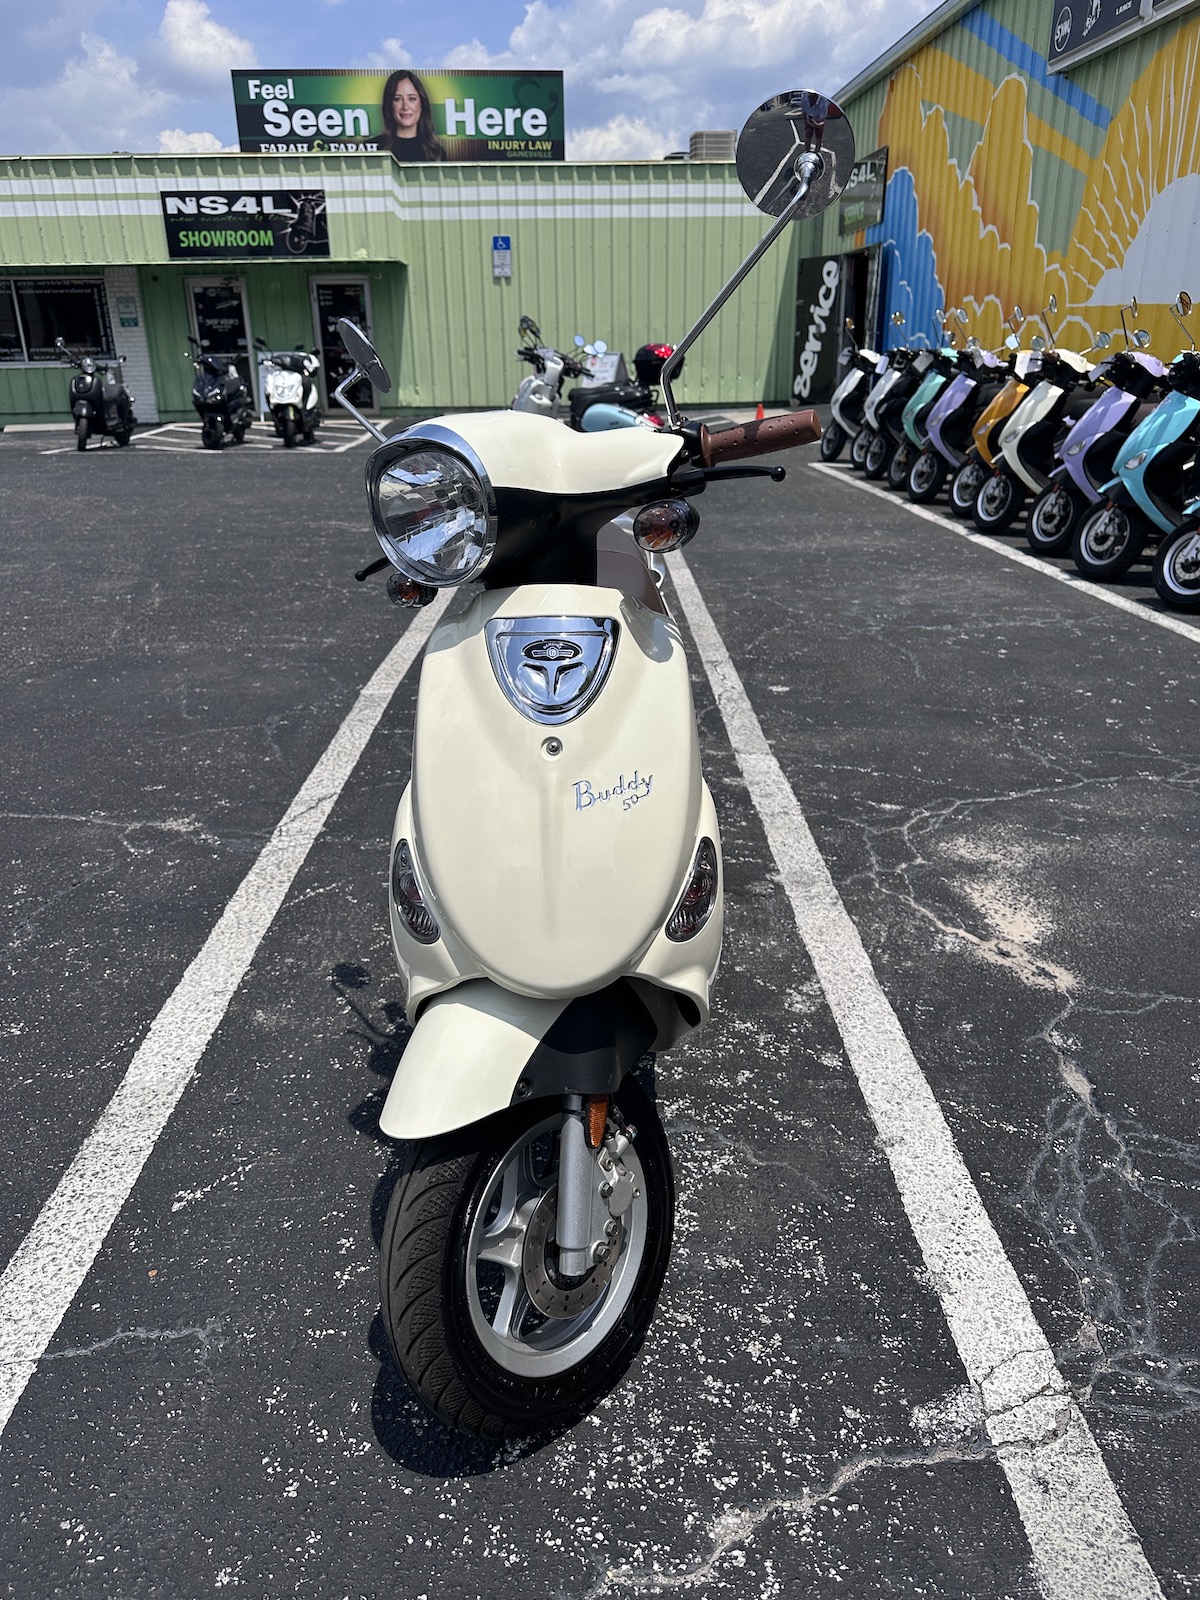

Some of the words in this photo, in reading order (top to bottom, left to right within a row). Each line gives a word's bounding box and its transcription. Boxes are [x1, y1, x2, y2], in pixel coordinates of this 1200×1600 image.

[1115, 1, 1133, 15] LANCE
[248, 78, 295, 100] Feel
[262, 99, 370, 137] Seen
[444, 98, 549, 137] Here
[487, 140, 527, 151] INJURY
[528, 140, 553, 151] LAW
[845, 160, 877, 190] S4L
[164, 195, 292, 215] NS4L
[178, 229, 275, 248] SHOWROOM
[571, 770, 653, 812] Buddy
[622, 794, 640, 812] 50
